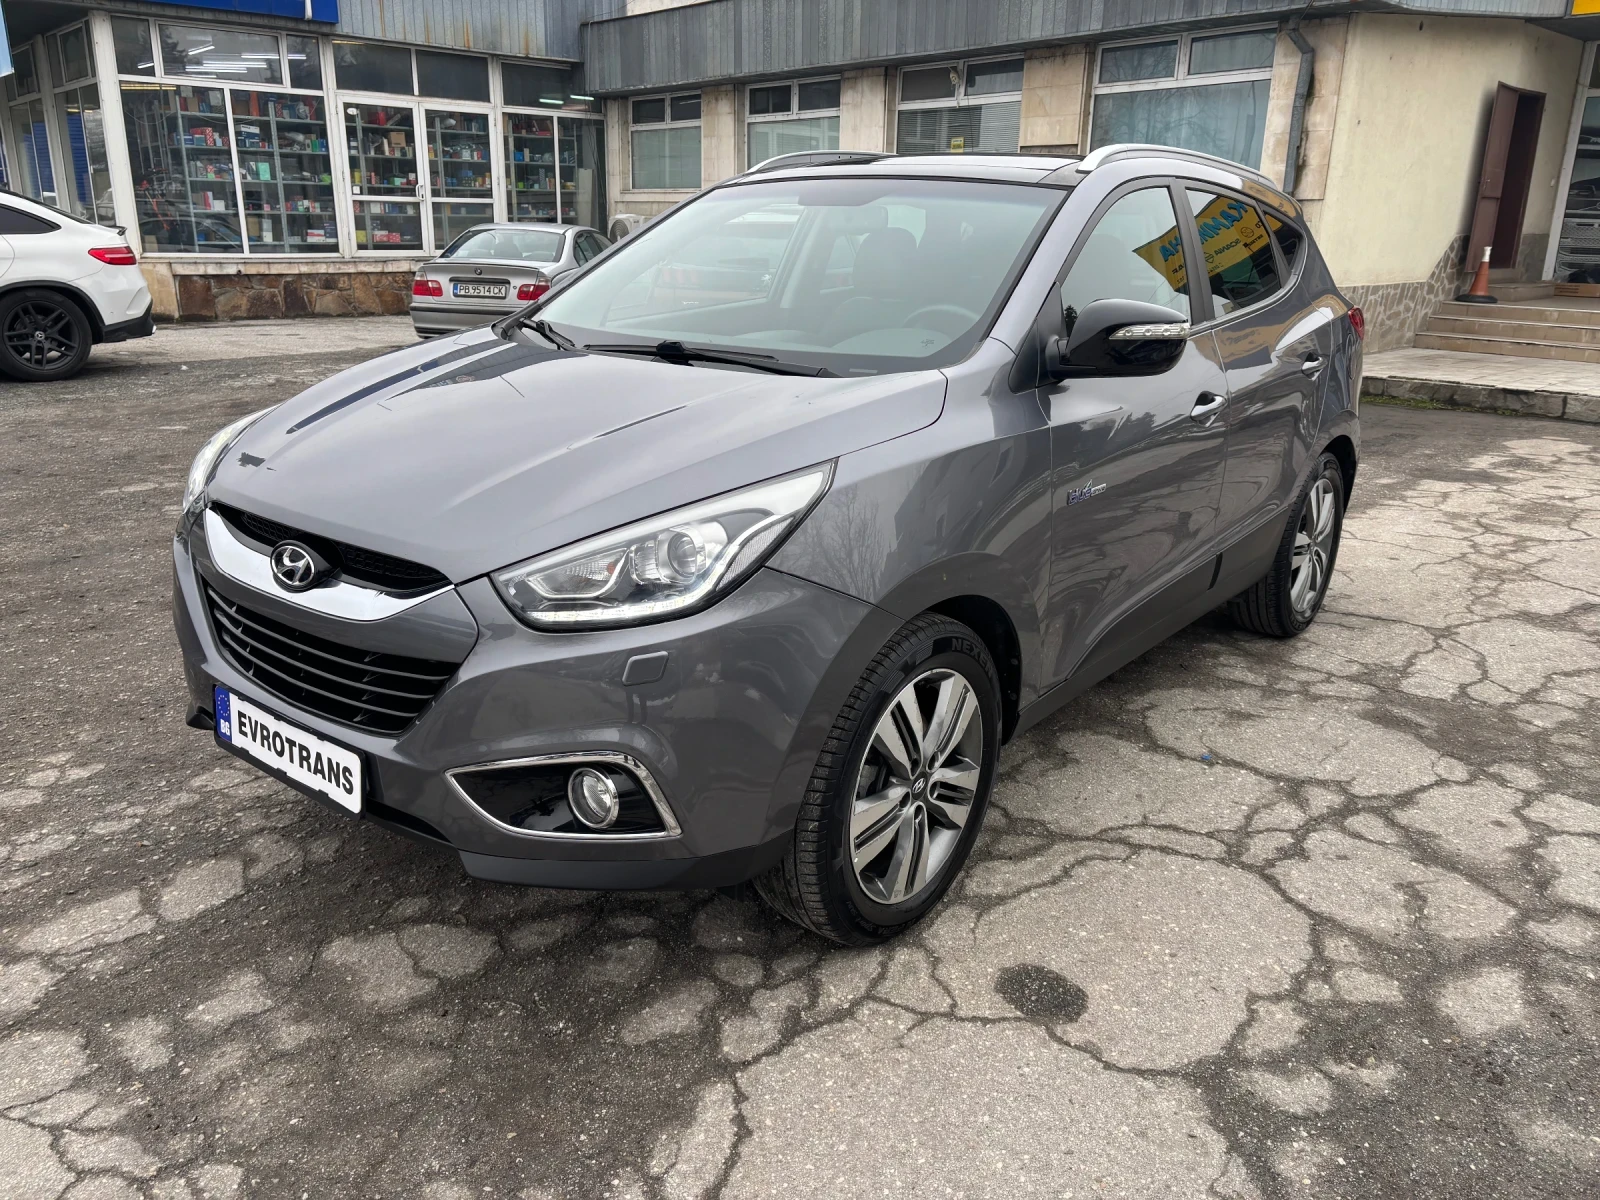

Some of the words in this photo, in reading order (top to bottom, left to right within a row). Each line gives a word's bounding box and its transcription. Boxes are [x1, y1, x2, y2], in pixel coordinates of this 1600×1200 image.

[951, 638, 992, 678] NEXEN
[220, 718, 231, 736] BG
[237, 710, 354, 796] EVROTRANS
